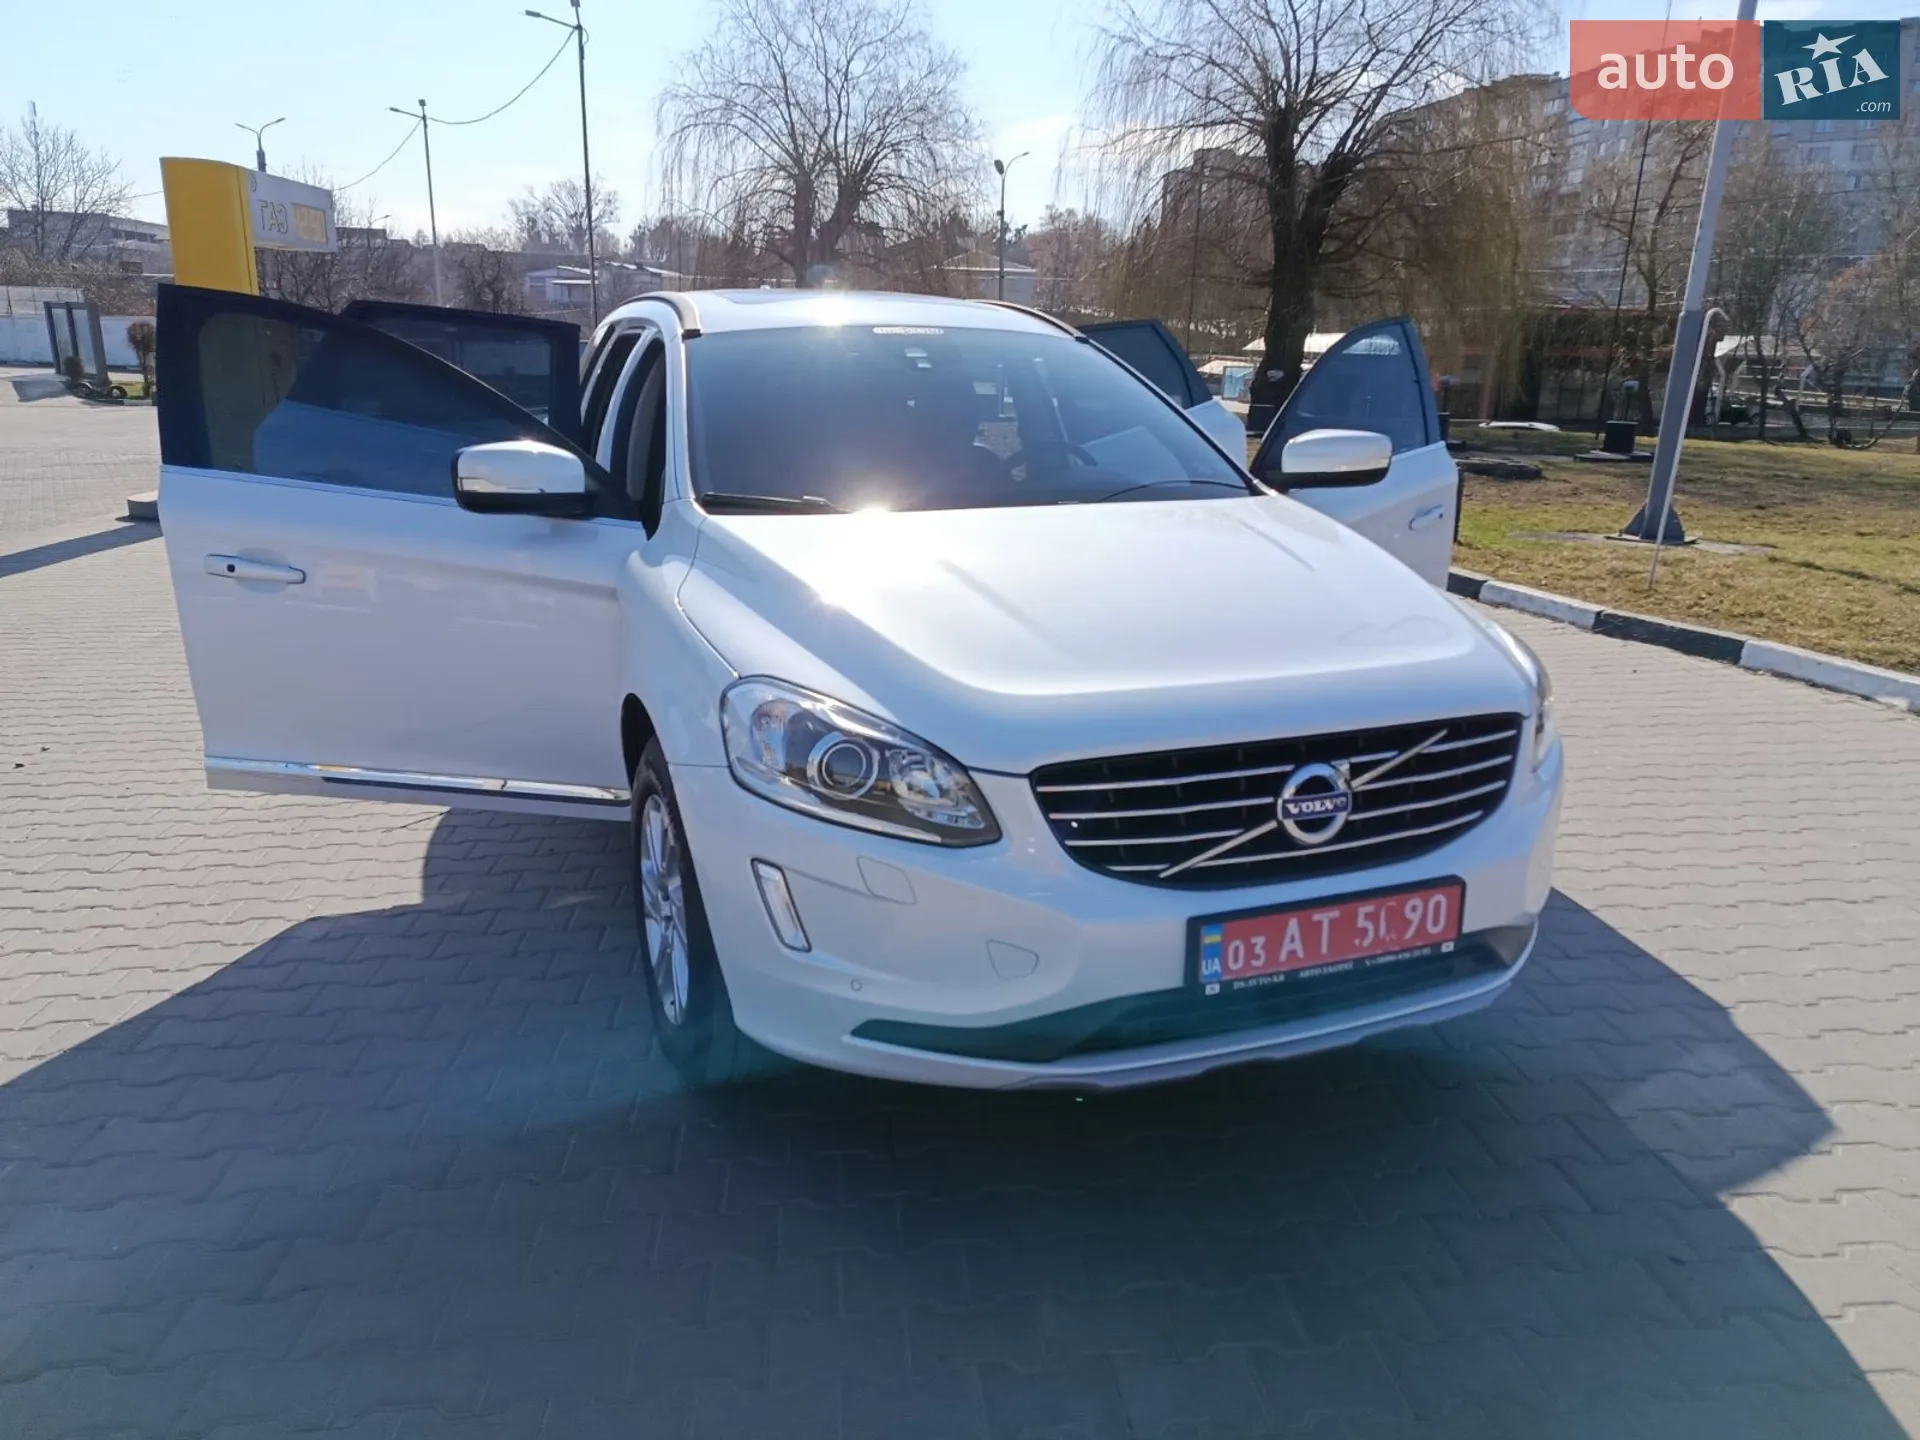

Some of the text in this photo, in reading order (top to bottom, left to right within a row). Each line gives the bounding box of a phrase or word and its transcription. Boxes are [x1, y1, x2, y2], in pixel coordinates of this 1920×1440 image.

[257, 199, 288, 234] ГАЗ
[1285, 796, 1347, 815] VOLVO
[1227, 936, 1266, 971] 03
[1201, 958, 1221, 977] UA
